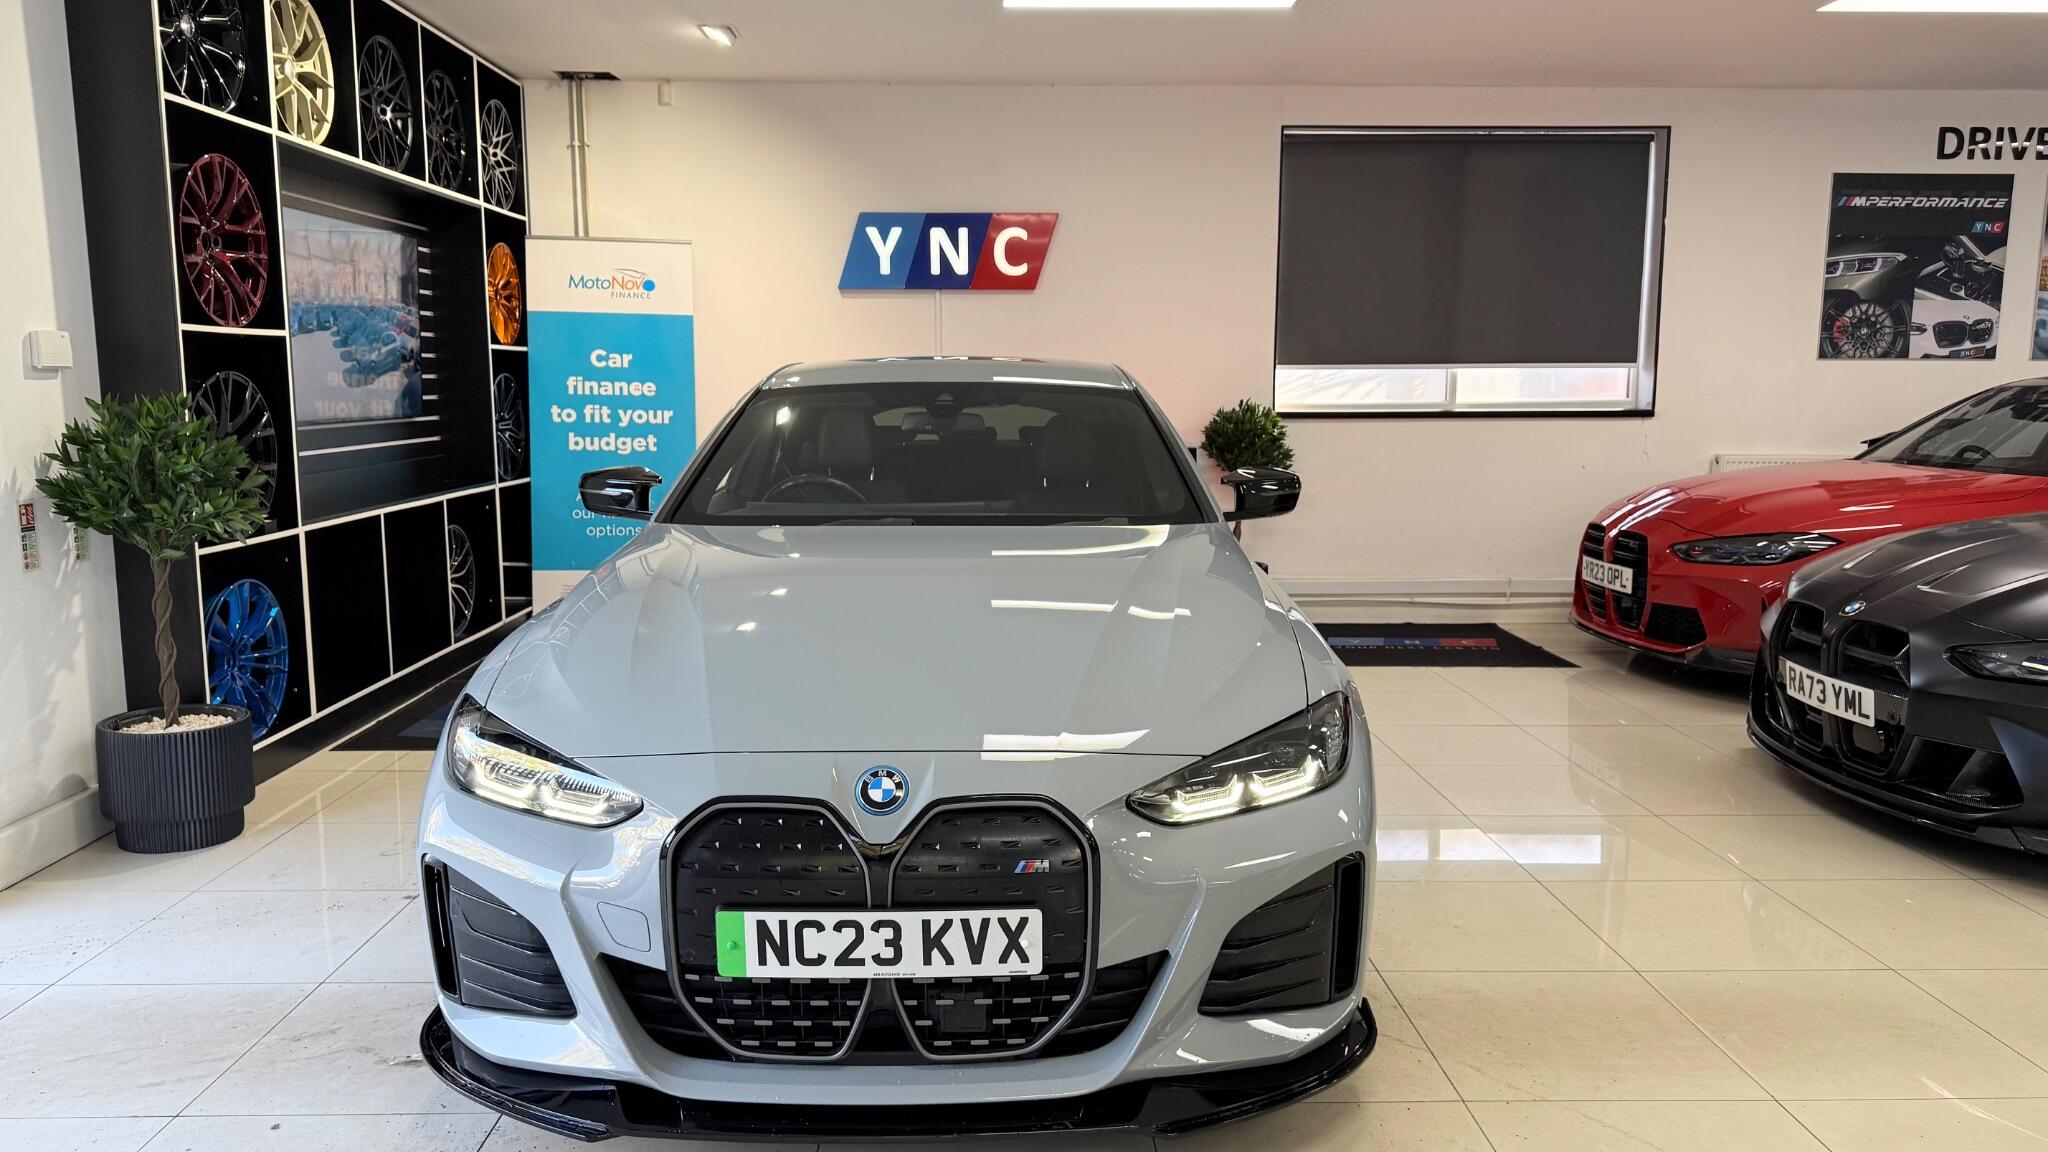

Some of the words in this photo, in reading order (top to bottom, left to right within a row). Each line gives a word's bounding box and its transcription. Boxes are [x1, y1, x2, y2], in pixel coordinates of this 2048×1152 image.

[1975, 222, 2001, 233] YNC
[865, 226, 1028, 276] YNC
[610, 291, 651, 300] FINANCE
[590, 349, 633, 368] Car
[566, 376, 657, 396] finance
[550, 404, 577, 423] to
[584, 404, 611, 424] fit
[617, 409, 673, 428] your
[568, 432, 657, 455] budget
[586, 525, 642, 538] options
[1584, 559, 1605, 582] YR23
[1607, 568, 1626, 590] OPL
[1788, 665, 1826, 704] RA73
[1831, 683, 1870, 720] YML
[756, 919, 903, 967] NC23
[921, 916, 1030, 966] KVX
